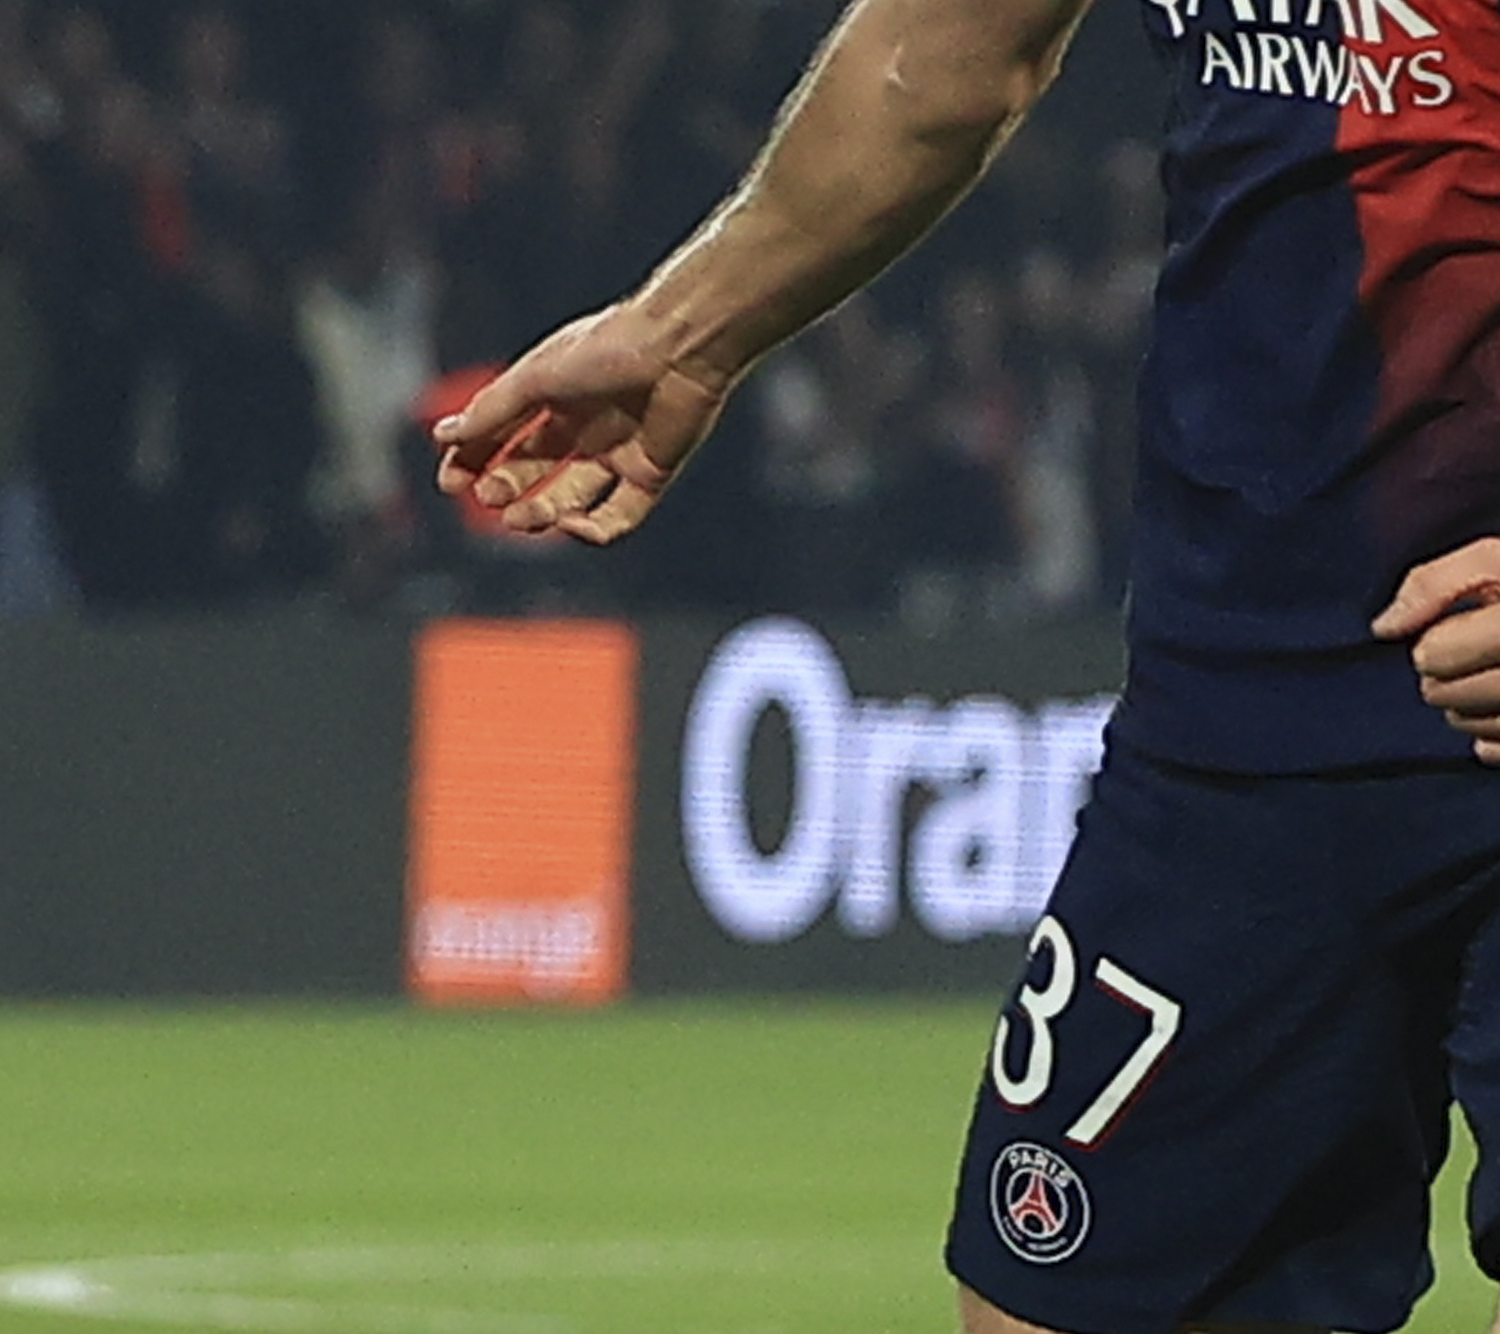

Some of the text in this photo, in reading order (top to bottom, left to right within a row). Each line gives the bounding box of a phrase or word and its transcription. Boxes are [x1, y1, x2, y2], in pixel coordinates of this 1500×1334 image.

[1202, 32, 1453, 115] AIRWAYS
[992, 914, 1183, 1148] 37
[1008, 1150, 1073, 1187] PARIS
